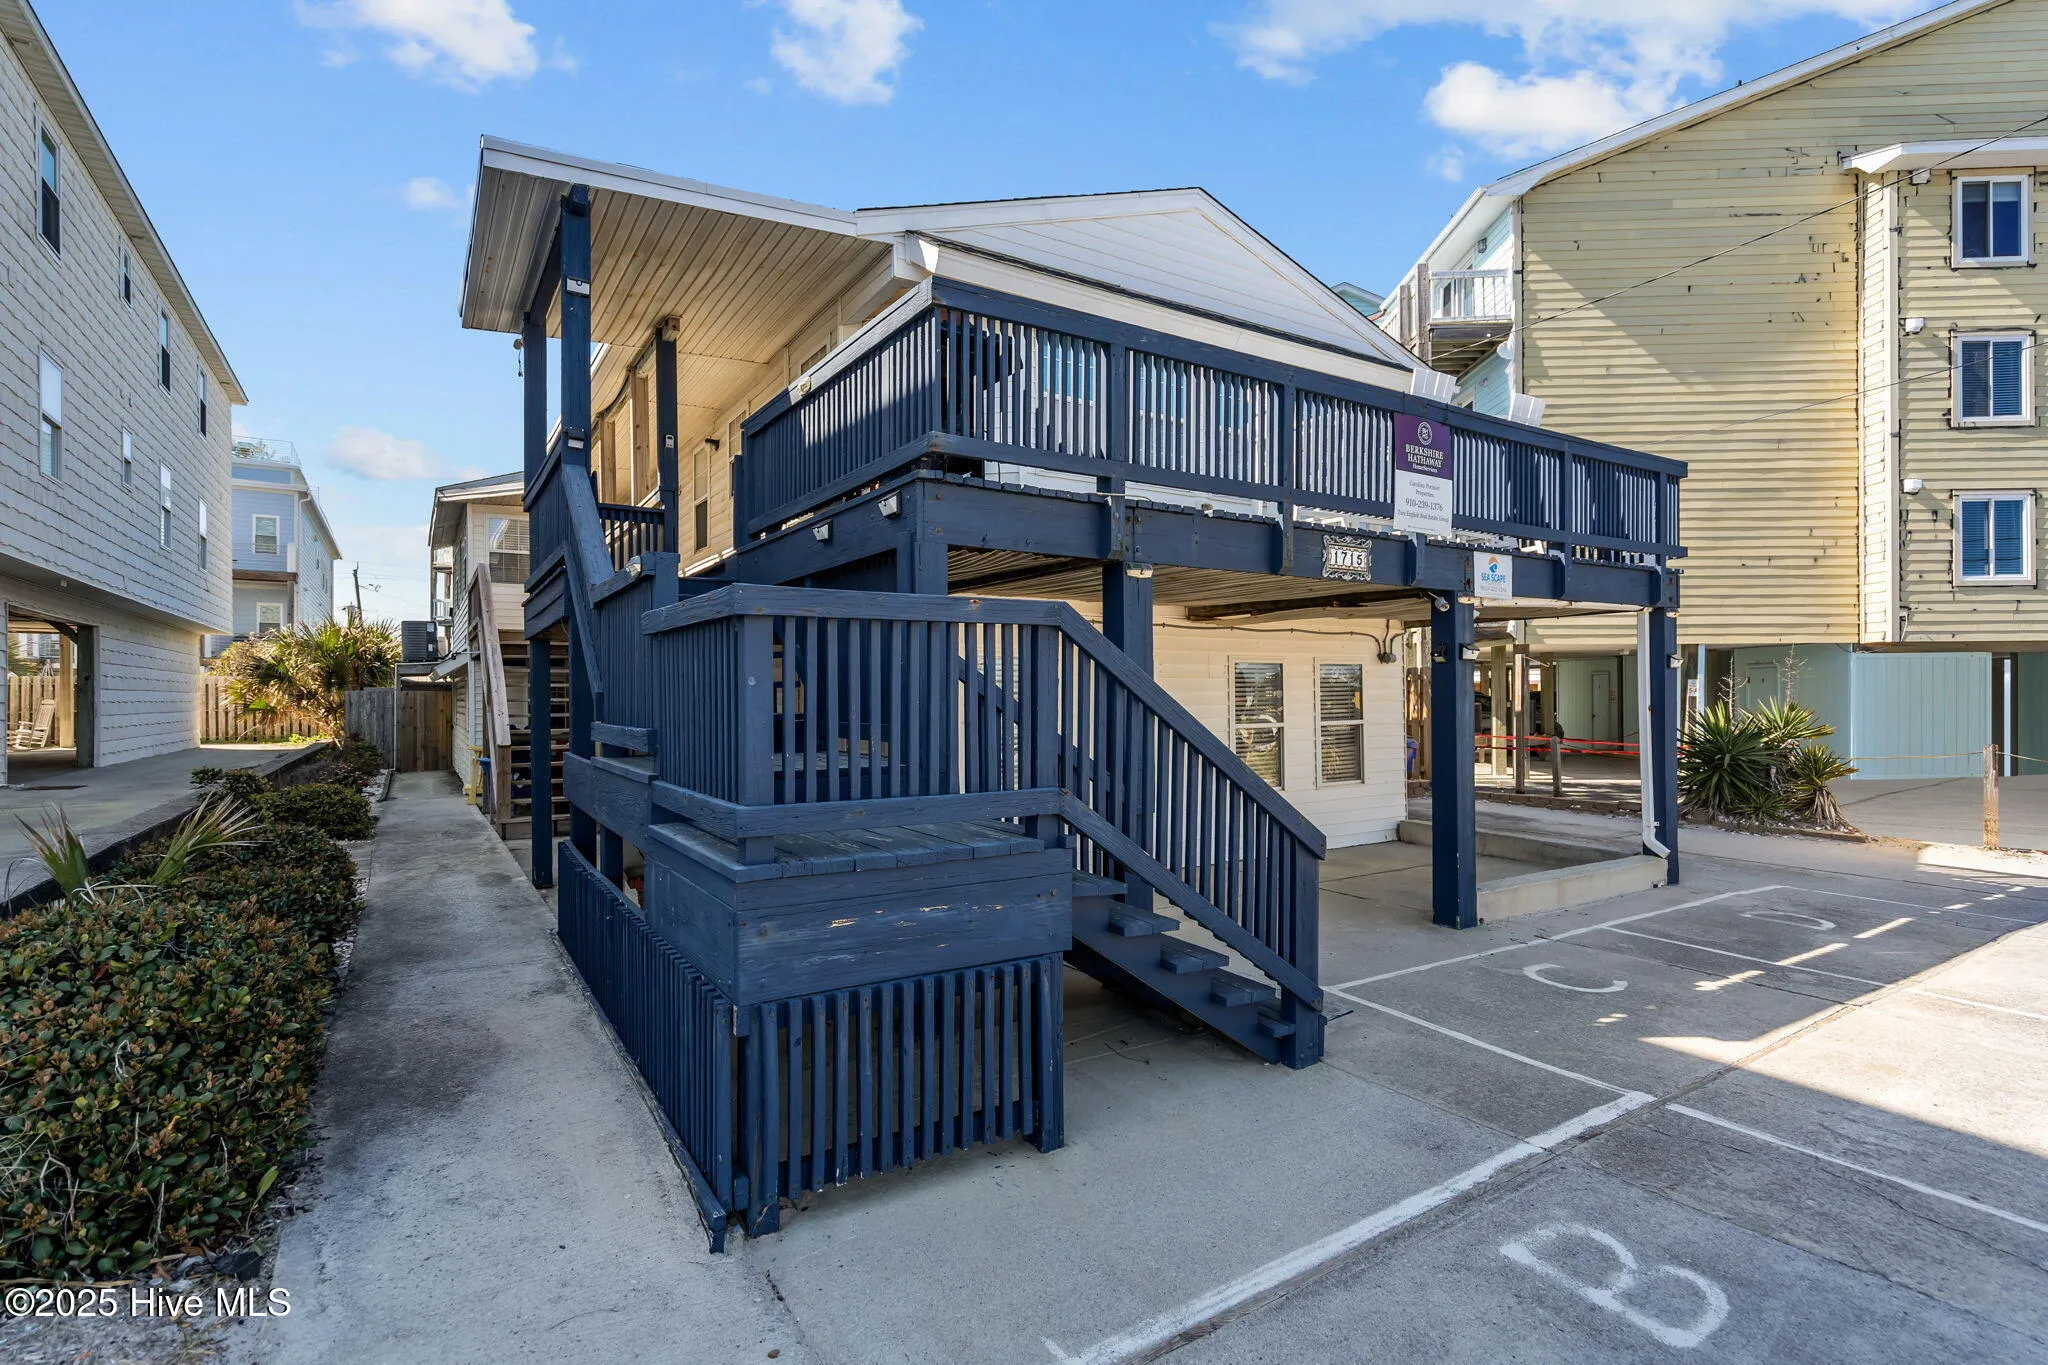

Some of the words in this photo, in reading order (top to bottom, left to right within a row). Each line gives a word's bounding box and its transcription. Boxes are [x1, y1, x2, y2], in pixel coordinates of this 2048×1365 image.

[1405, 444, 1444, 460] BERKSHIRE
[1407, 453, 1443, 468] HATHAWAY
[1334, 551, 1363, 566] 1715
[1480, 572, 1491, 582] SEA
[1491, 573, 1507, 584] SCAPE
[1499, 1221, 1730, 1349] B
